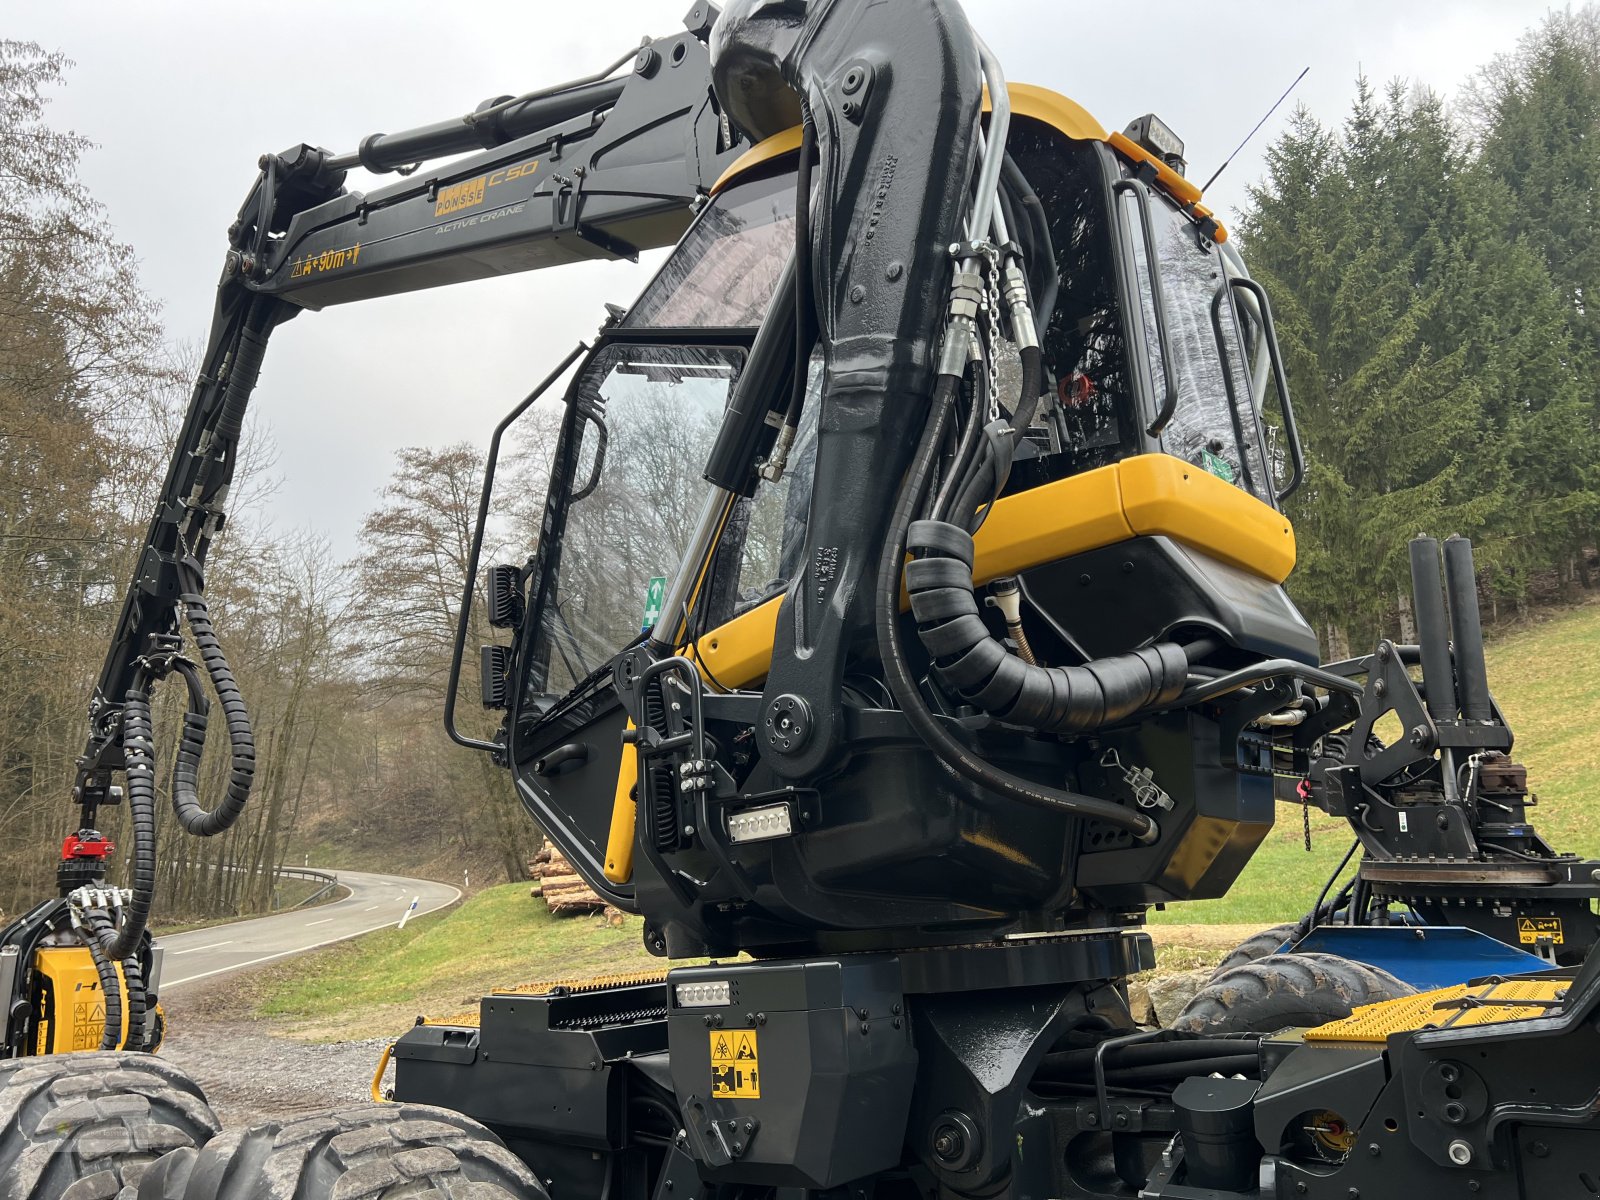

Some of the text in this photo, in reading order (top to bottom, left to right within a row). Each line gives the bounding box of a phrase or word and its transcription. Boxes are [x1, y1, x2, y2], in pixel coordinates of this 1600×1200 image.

[436, 189, 483, 213] PONSSE
[435, 204, 525, 235] ACTIVE CRANE
[319, 249, 345, 271] 90m
